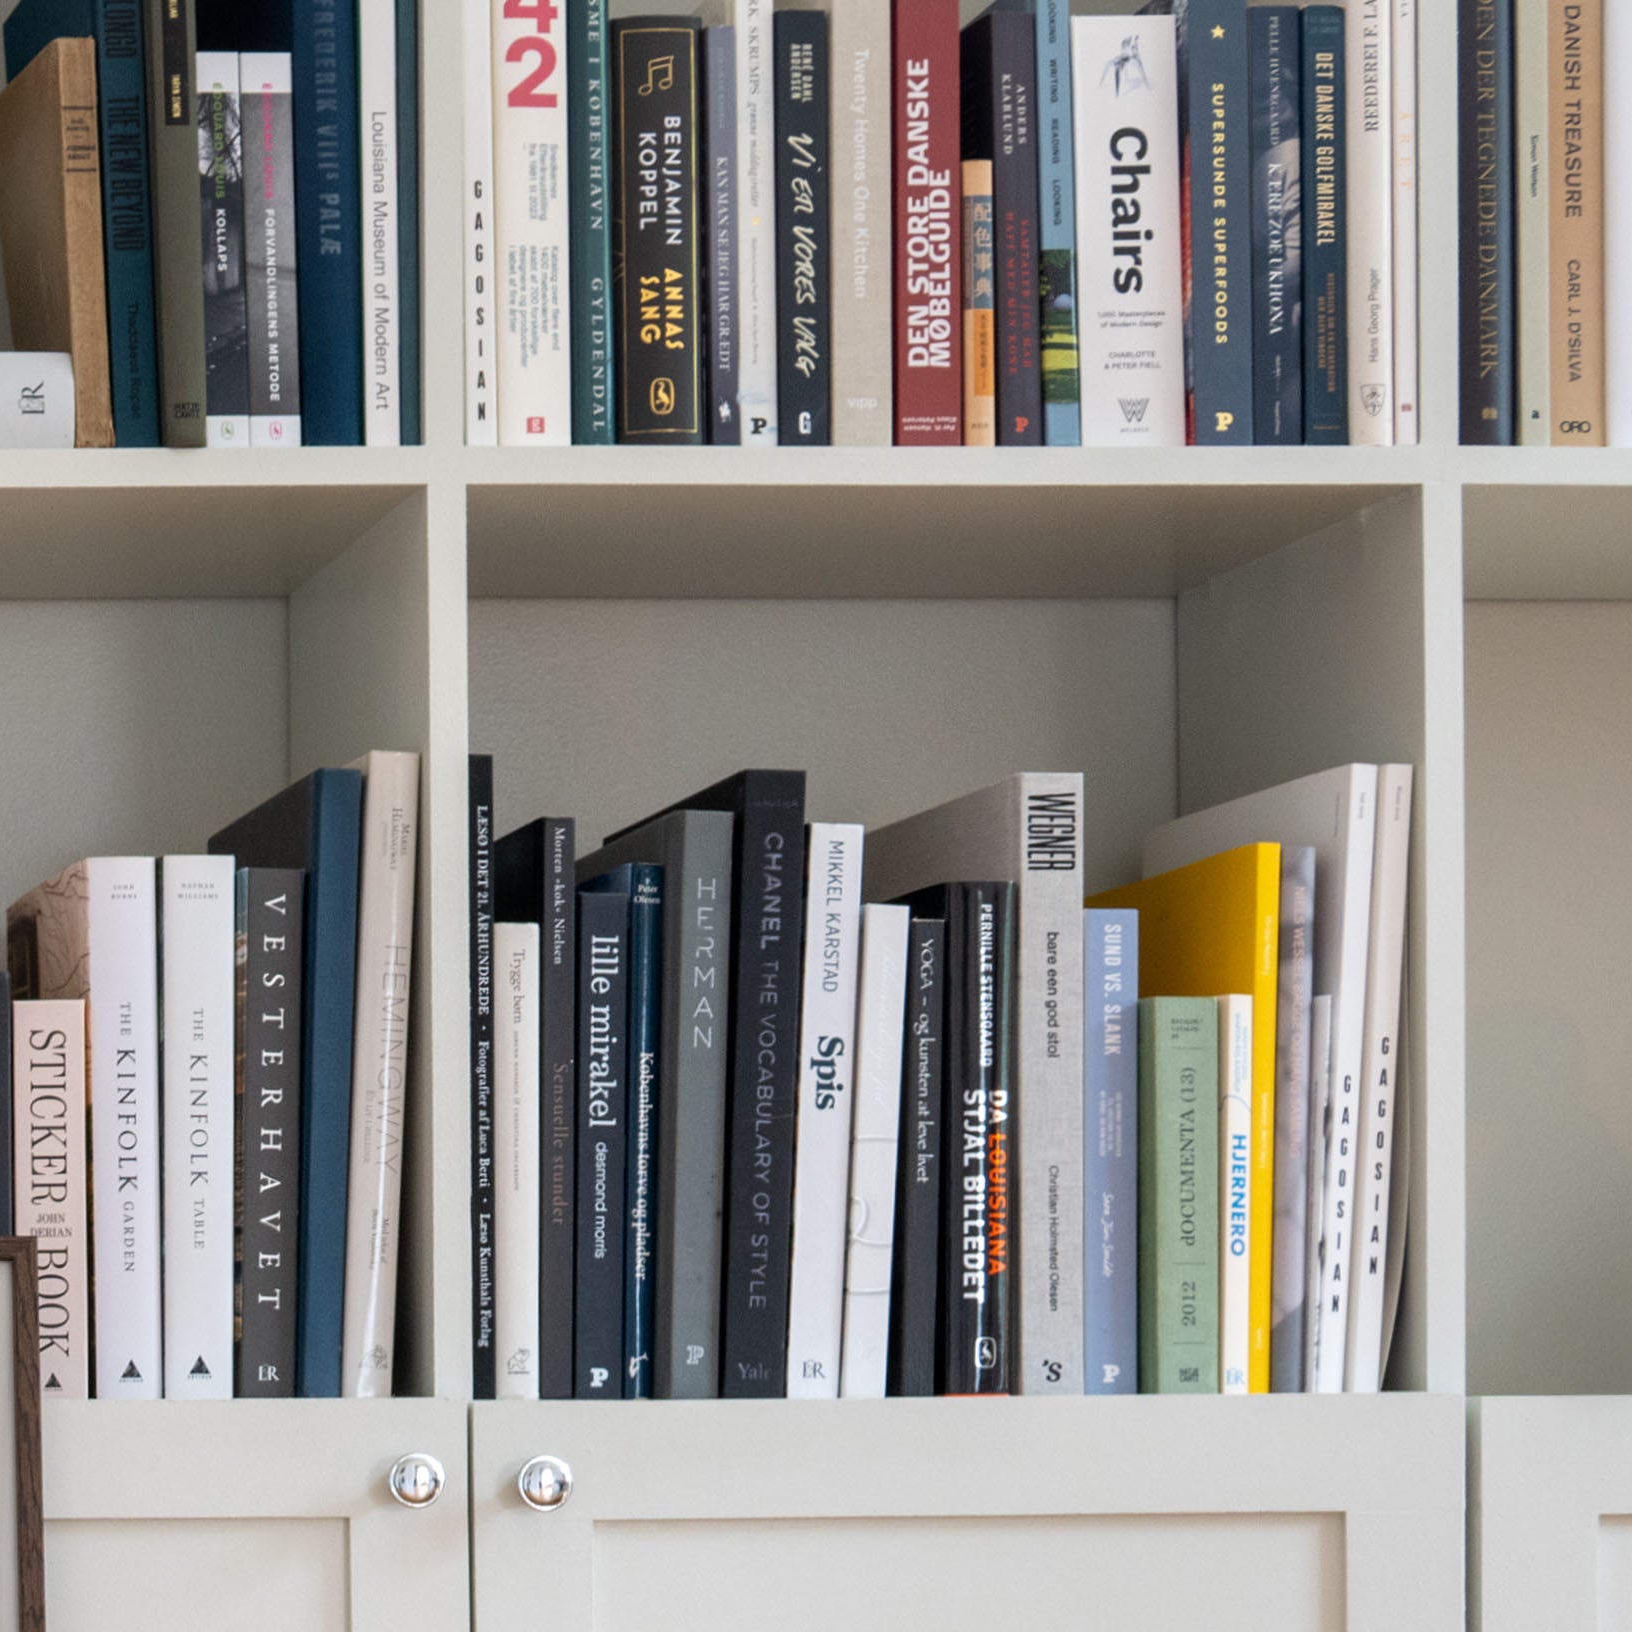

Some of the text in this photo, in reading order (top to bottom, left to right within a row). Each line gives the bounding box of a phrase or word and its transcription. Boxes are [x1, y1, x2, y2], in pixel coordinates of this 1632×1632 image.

[790, 44, 801, 100] ANDERSEN
[801, 44, 813, 102] RENÉ DAHL
[1002, 74, 1012, 155] KLARLUND
[1016, 85, 1027, 144] ANDERS
[107, 96, 145, 251] THE NEW BEYOND
[639, 132, 657, 230] KOPPEL
[664, 115, 683, 245] BENJAMIN
[852, 49, 870, 297] Twenty Homes One Kitchen
[907, 59, 928, 367] DEN STORE DANSKE
[1110, 127, 1153, 294] Chairs
[1213, 83, 1228, 344] SUPERSUNDE SUPERFOODS
[1315, 53, 1335, 246] DET DANSKE GOLFMIRAKEL
[1564, 5, 1582, 382] DANISH TREASURE CARL J. D'SILVA
[215, 208, 228, 271] KOLLAPS
[319, 193, 341, 255] PALÆ
[371, 111, 391, 410] Louisiana Museum of Modern Art
[589, 79, 605, 432] KØBENHAVN GYLDENDAL
[792, 225, 818, 303] VORES
[929, 169, 951, 367] MØBELGUIDE
[1477, 50, 1497, 378] DER TEGNEDE DANMARK
[265, 208, 280, 401] FORVANDLINGENS METODE
[474, 181, 486, 421] GAGOSIAN
[640, 276, 660, 344] SANG
[664, 268, 684, 349] ANNAS
[796, 317, 818, 378] VALG
[1269, 258, 1283, 335] UKHONA
[1561, 421, 1591, 433] ORO
[477, 805, 488, 843] LÆSØ
[477, 857, 488, 887] DET
[1027, 793, 1076, 870] WEGNER
[477, 891, 488, 906] 21.
[694, 877, 717, 1048] HERMAN
[823, 840, 844, 992] MIKKEL KARSTAD
[477, 911, 491, 1015] ÅRHUNDREDE
[552, 827, 570, 1225] Morten Nielsen Sensuelle stunder
[981, 903, 993, 1067] PERNILLE STENSGAARD
[1045, 932, 1060, 1058] bare een god stol
[1104, 924, 1123, 1055] SUND VS. SLANK
[258, 894, 287, 1310] VESTERHAVET
[374, 945, 409, 1175] HEMINGWAY
[476, 1041, 489, 1106] Fotografier
[478, 1109, 490, 1122] af
[589, 935, 617, 1258] lille mirakel desmond morris
[749, 832, 784, 1309] CHANEL THE VOCABULARY OF STYLE
[812, 1036, 845, 1110] Spis
[914, 938, 935, 1182] YOGA og kunsten at leve livet
[1177, 1067, 1197, 1103] (13)
[28, 1030, 70, 1358] STICKER BOOK
[117, 1049, 138, 1272] KINFOLK GARDEN
[190, 1054, 209, 1249] KINFOLK TABLE
[478, 1125, 490, 1155] Luca
[479, 1158, 490, 1187] Berti
[962, 1090, 984, 1303] STJAL BILLEDET
[988, 1090, 1007, 1274] DA LOUISIANA
[1230, 1135, 1247, 1256] HJERNERO
[1370, 1037, 1390, 1274] GAGOSIAN
[479, 1213, 490, 1242] Læsø
[479, 1246, 491, 1307] Kunsthals
[477, 1310, 491, 1347] Forlag
[1180, 1280, 1196, 1326] 2012
